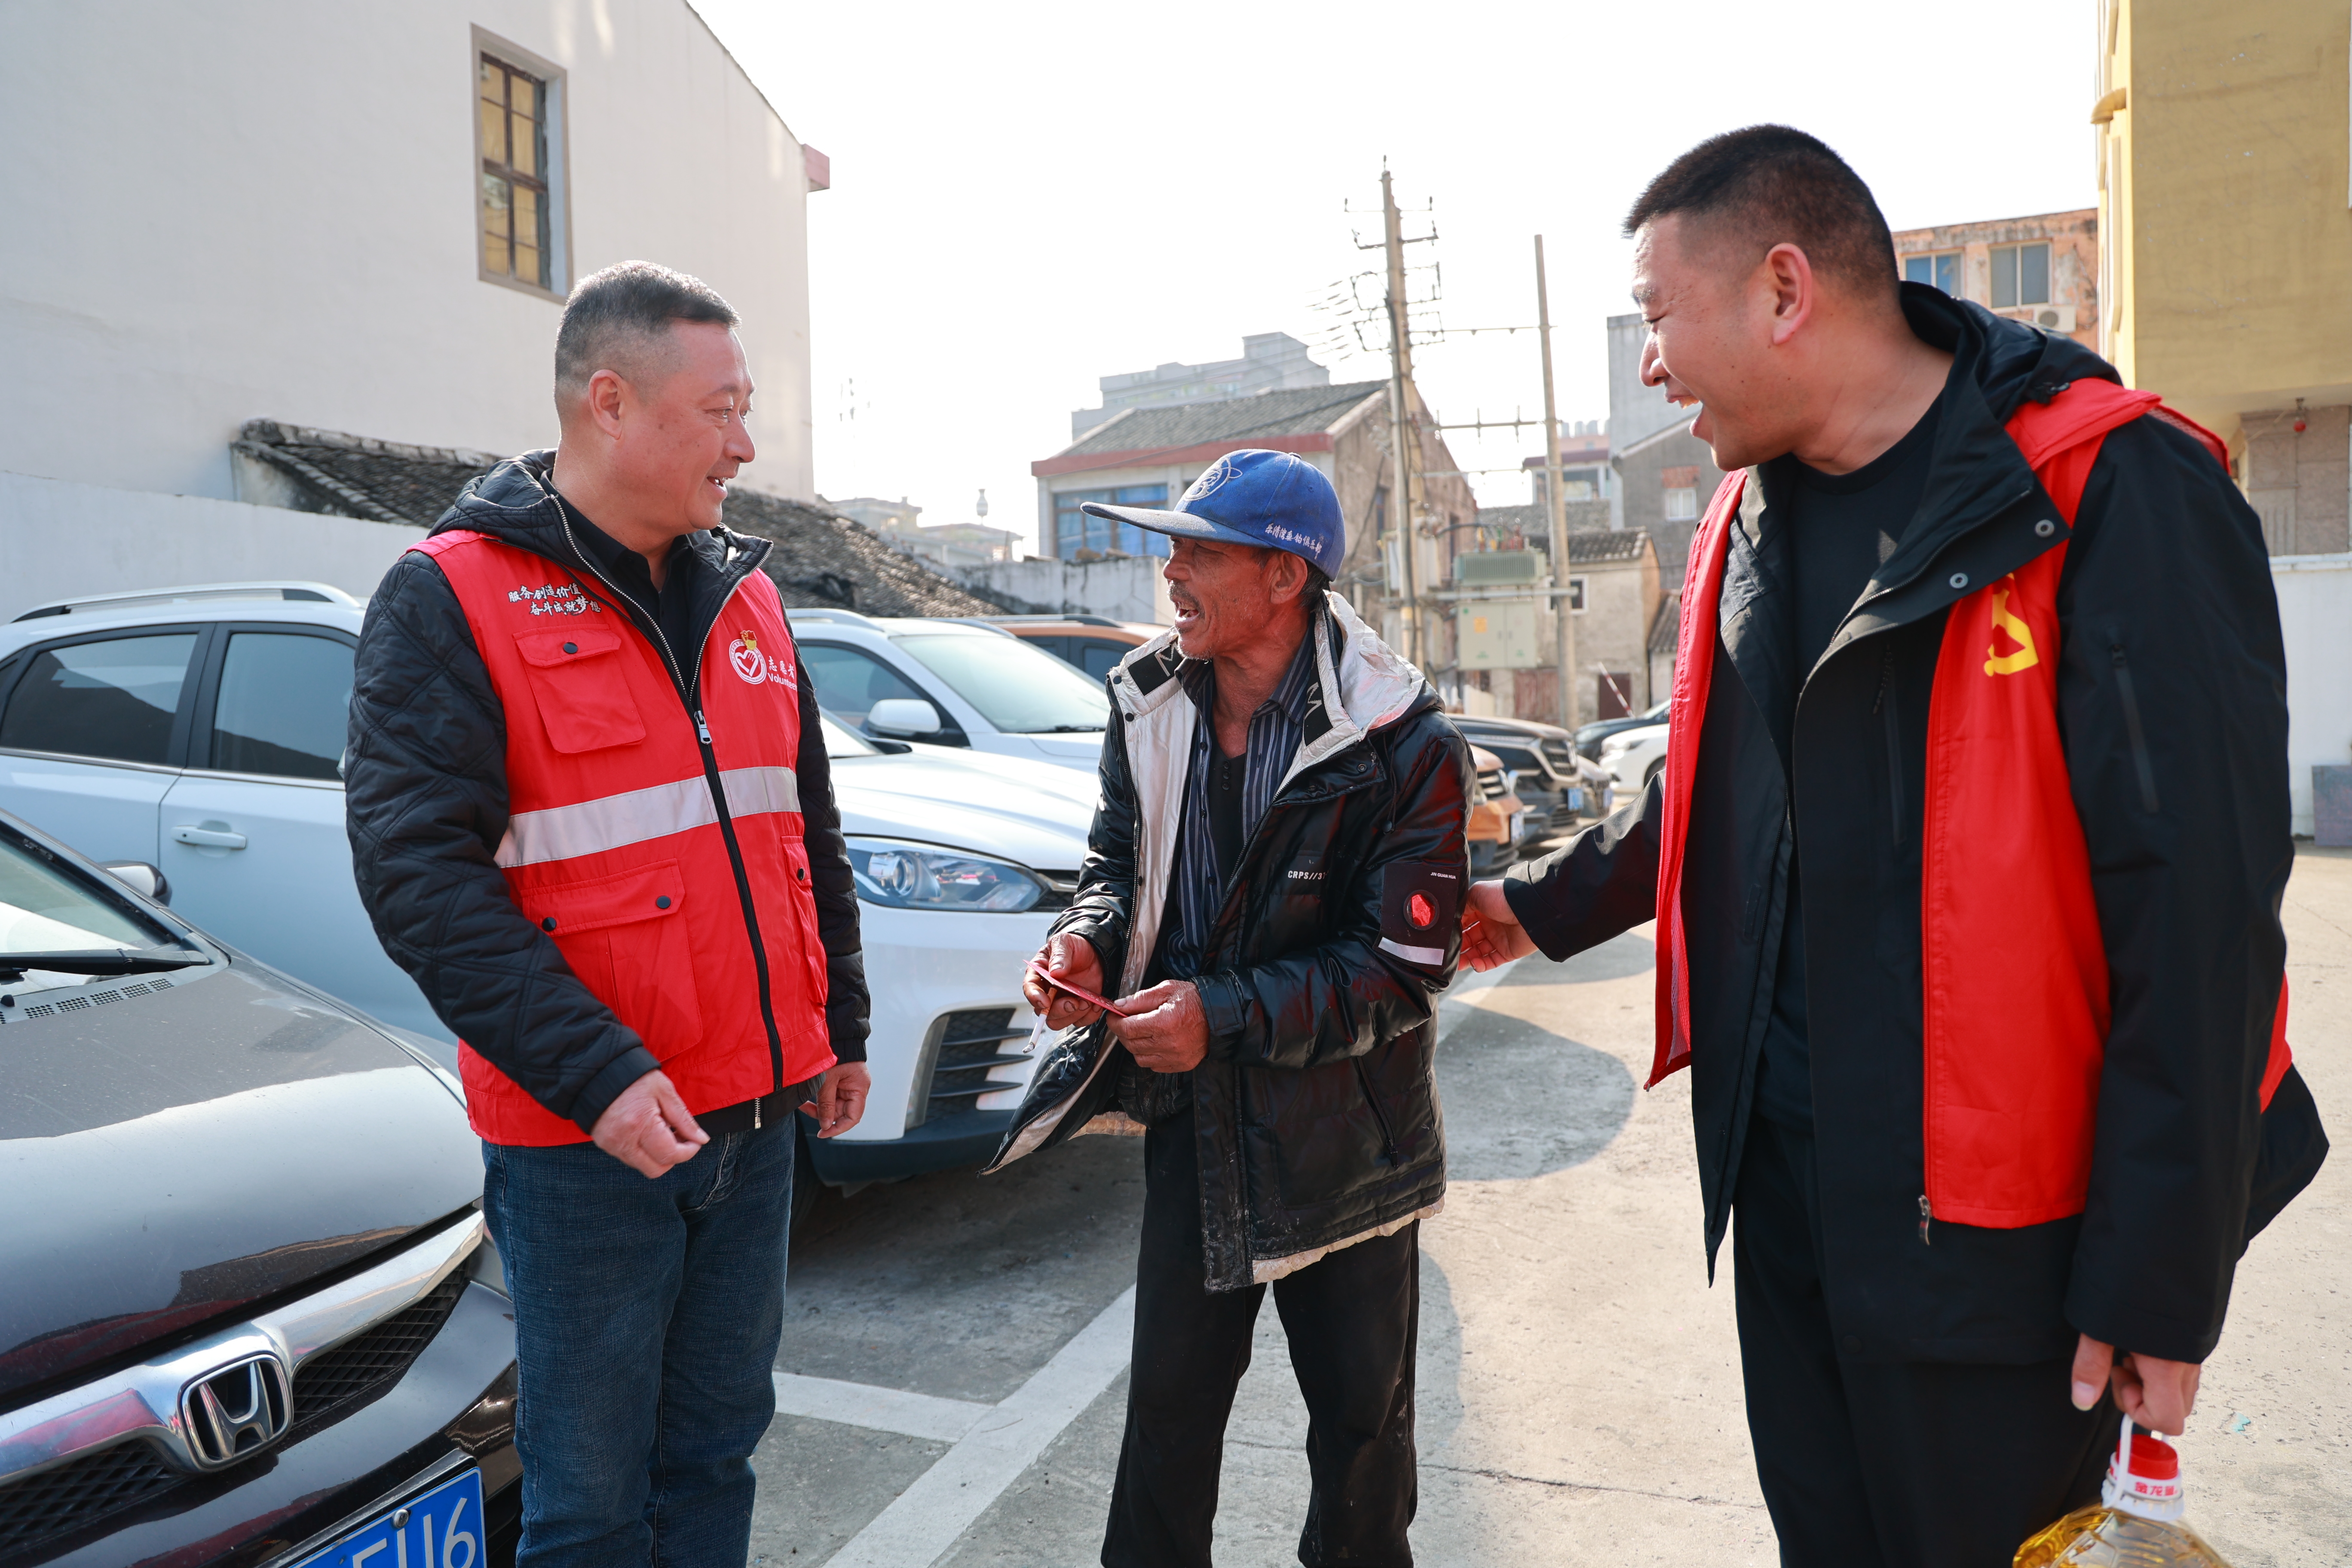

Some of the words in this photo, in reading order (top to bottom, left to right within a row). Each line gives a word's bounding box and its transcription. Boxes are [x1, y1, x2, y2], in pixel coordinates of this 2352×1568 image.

[508, 583, 581, 603] 服务创造价值
[530, 596, 601, 616] 奋斗成就梦想
[768, 655, 795, 679] 志愿者
